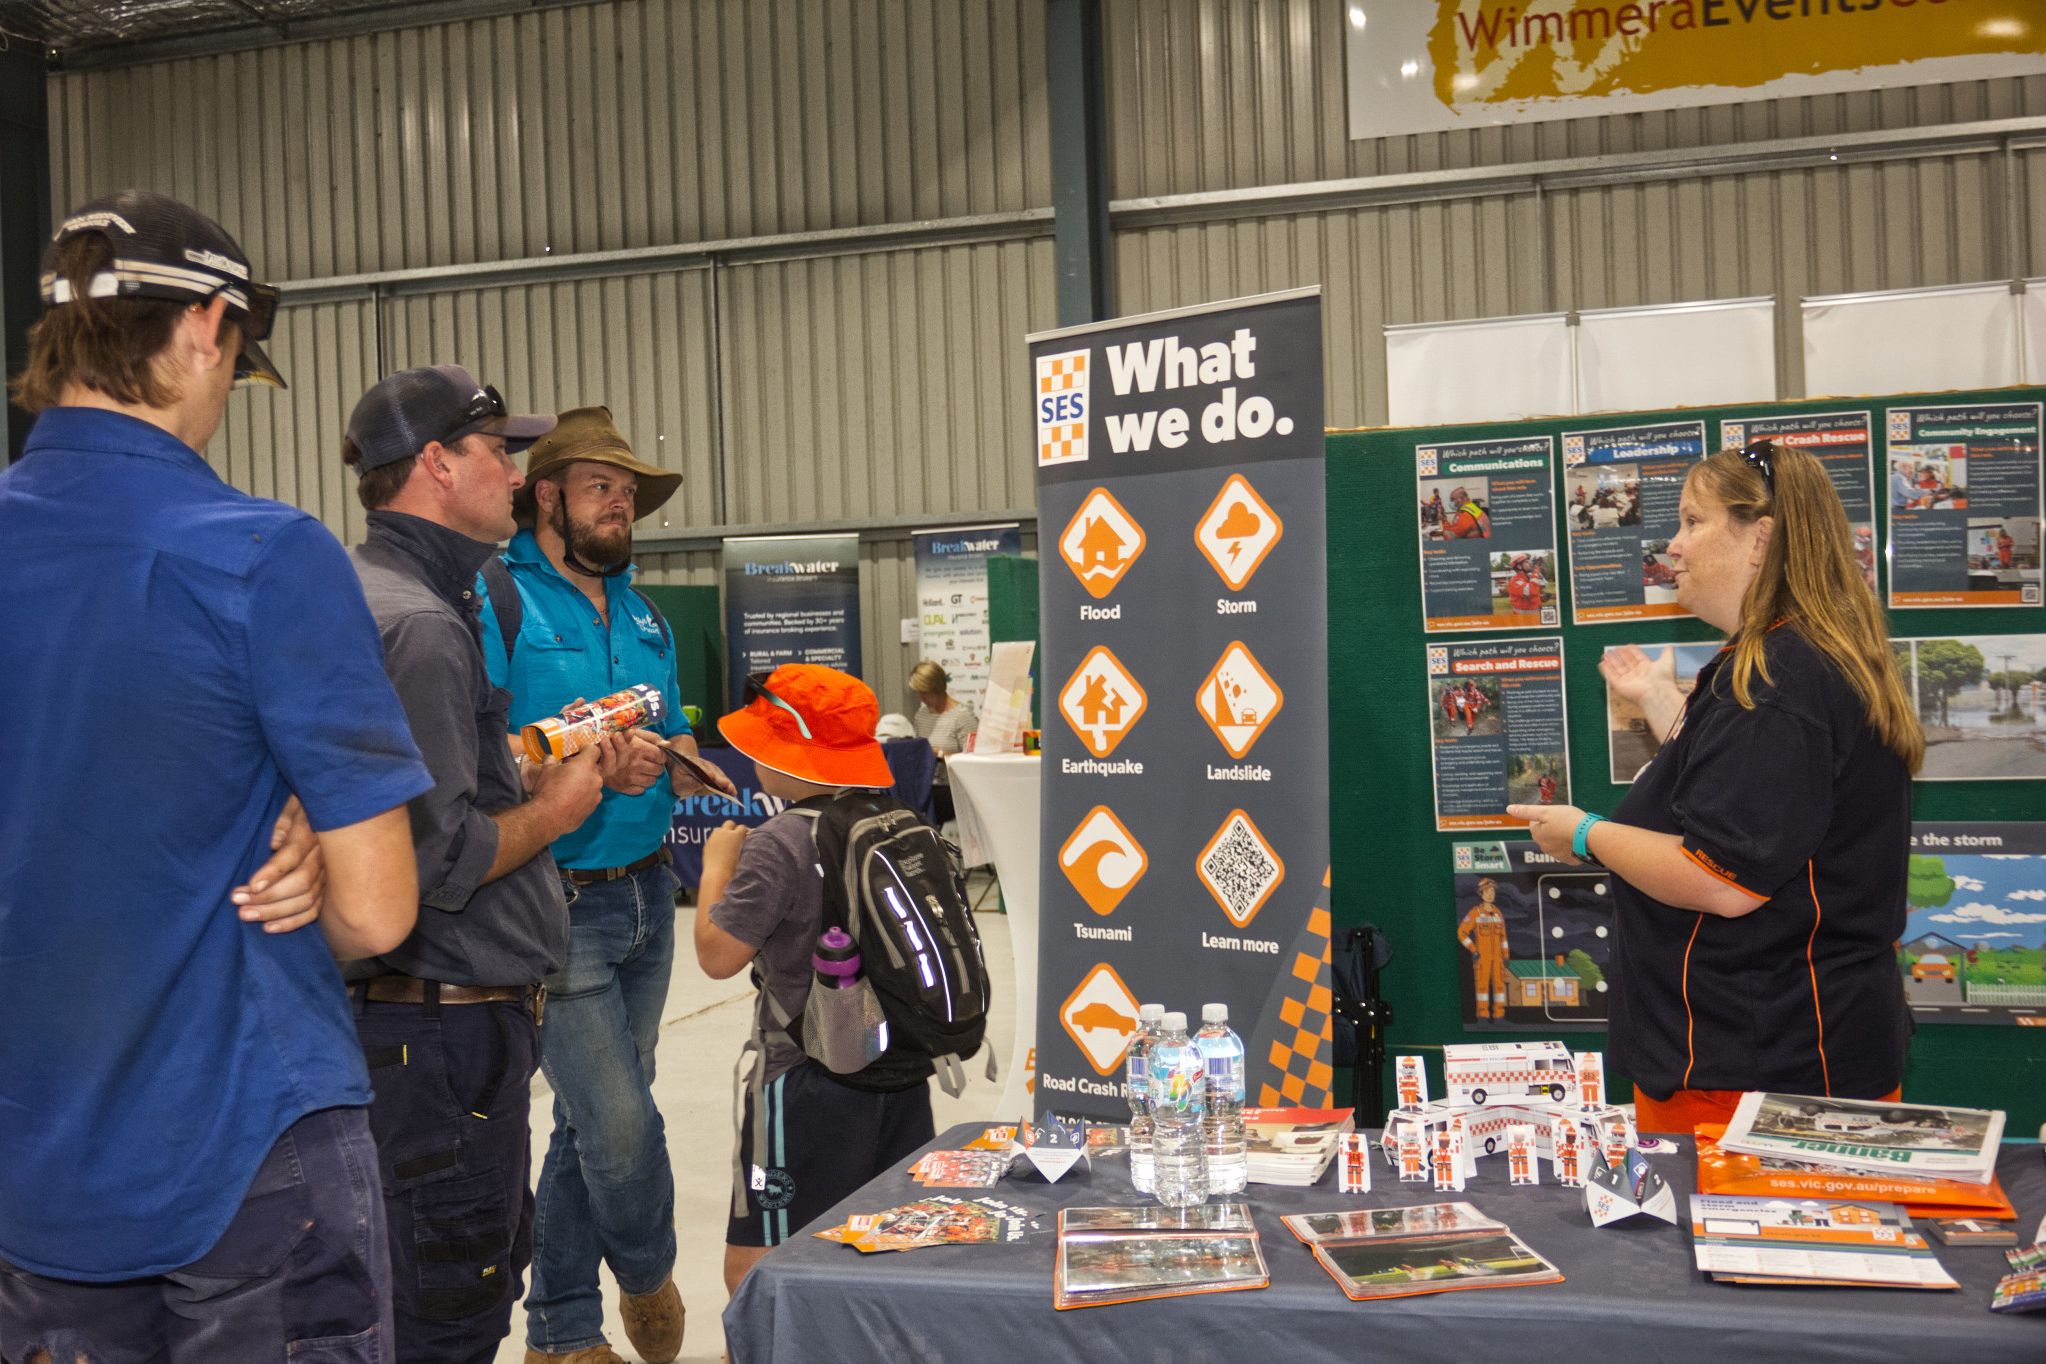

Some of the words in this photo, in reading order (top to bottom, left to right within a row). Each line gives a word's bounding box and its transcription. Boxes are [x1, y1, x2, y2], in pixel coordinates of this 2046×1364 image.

[1105, 328, 1257, 396] What
[1041, 392, 1084, 424] SES
[1104, 407, 1190, 454] we
[1201, 386, 1295, 444] do.
[1785, 434, 1820, 446] Crash
[1822, 432, 1866, 442] Rescue
[1918, 427, 1973, 437] Community
[1974, 426, 2036, 436] Engagement
[1613, 444, 1680, 459] Leadership
[1449, 459, 1544, 472] Communications
[932, 540, 999, 554] Breakwater
[744, 561, 839, 576] Breakwater
[1080, 605, 1121, 620] Flood
[1217, 599, 1257, 614] Storm
[775, 611, 799, 619] regional
[1456, 662, 1493, 672] Search
[1494, 660, 1517, 670] and
[1518, 659, 1559, 668] Rescue
[1062, 759, 1144, 777] Earthquake
[1207, 765, 1272, 782] Landslide
[1910, 837, 1918, 846] e
[1922, 834, 1950, 846] the
[1954, 834, 2002, 846] storm
[1474, 854, 1504, 862] Storm
[1474, 861, 1504, 870] Smart
[1695, 849, 1738, 880] RESCUE
[1074, 923, 1132, 941] Tsunami
[1202, 932, 1240, 950] Learn
[1243, 938, 1279, 954] more
[1043, 1074, 1076, 1092] Road
[1078, 1078, 1118, 1097] Crash
[1050, 1134, 1058, 1144] 2
[1791, 1140, 1912, 1162] Banner
[1611, 1174, 1618, 1185] 1
[1770, 1178, 1936, 1194] ses.vic.gov.au/prepare
